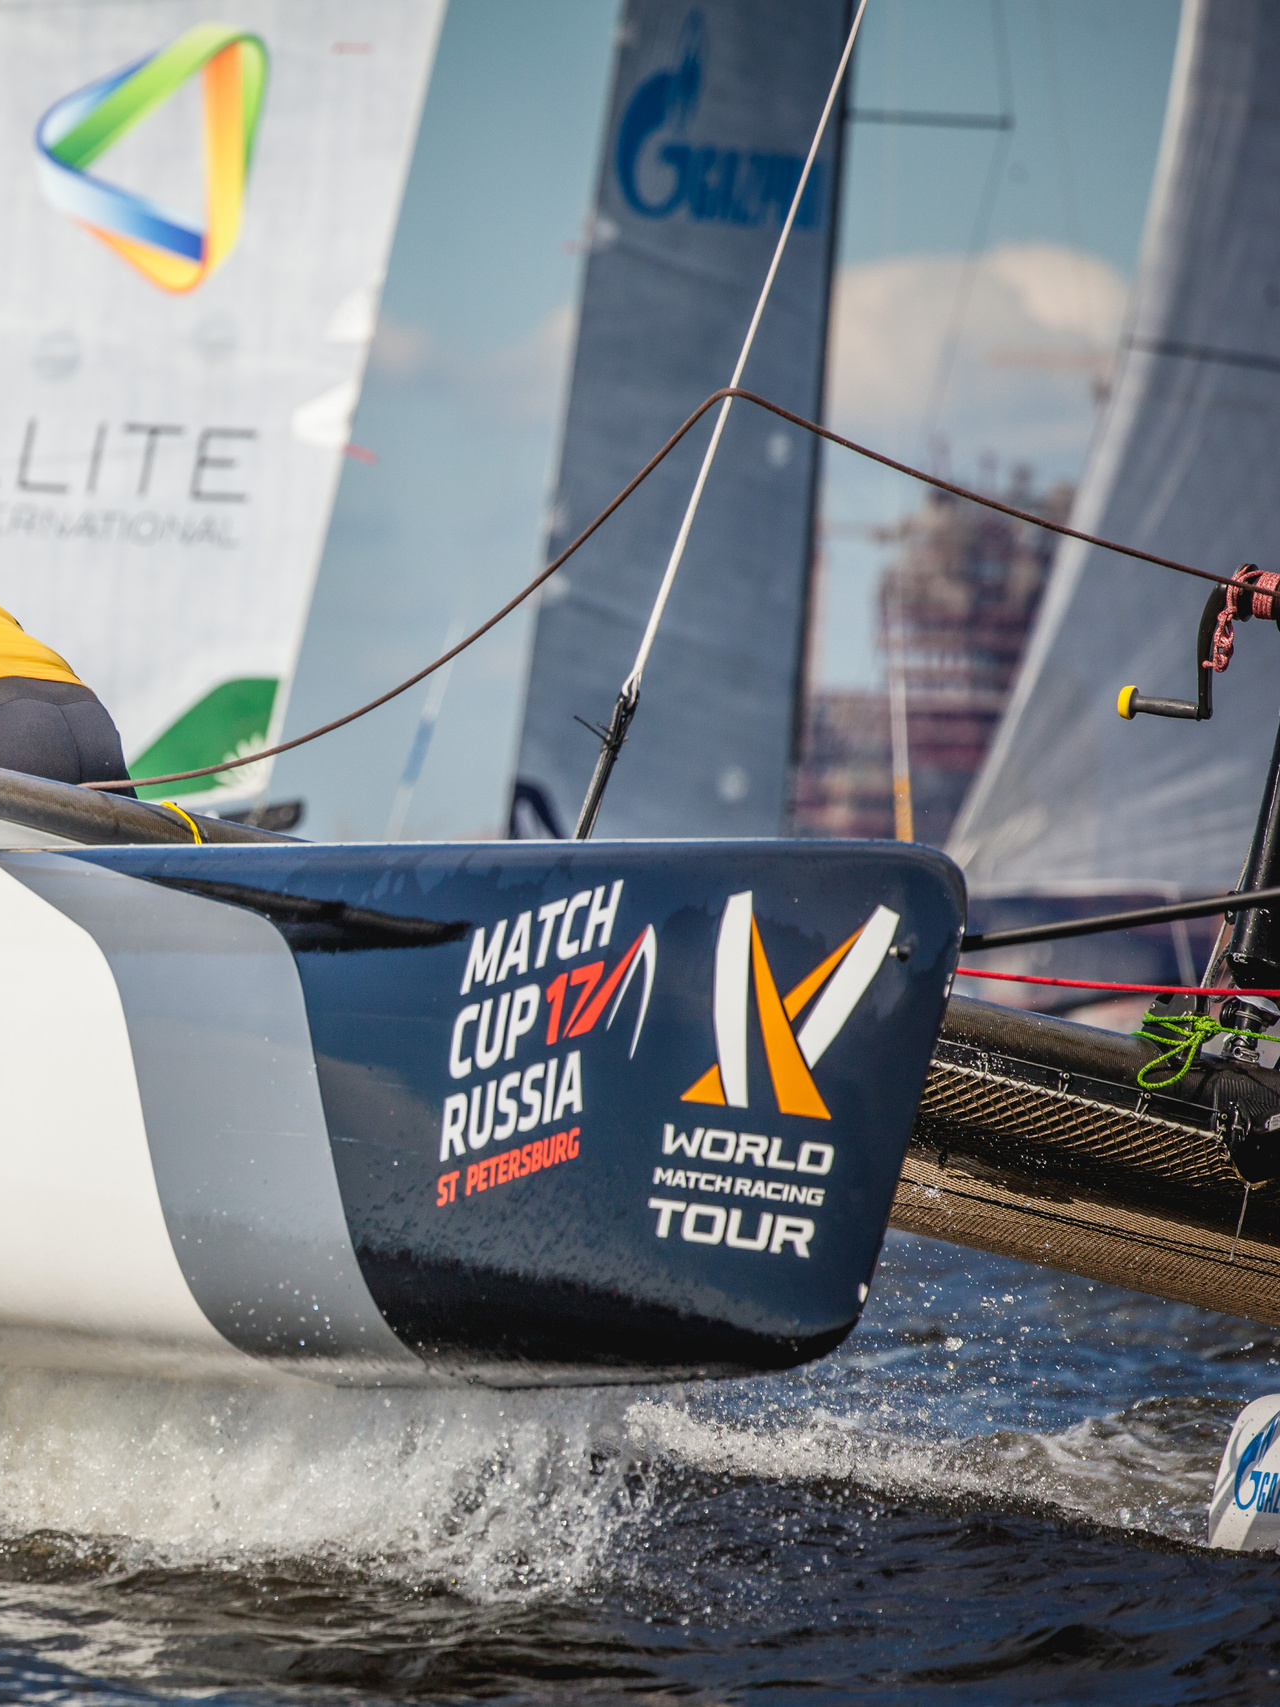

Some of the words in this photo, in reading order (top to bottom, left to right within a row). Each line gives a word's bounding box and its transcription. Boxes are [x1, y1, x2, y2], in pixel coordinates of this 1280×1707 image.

[459, 879, 624, 995] MATCH
[449, 983, 541, 1079] CUP
[439, 1050, 583, 1162] RUSSIA
[436, 1170, 460, 1207] ST
[465, 1127, 580, 1196] PETERSBURG
[652, 1166, 732, 1195] MATCH
[733, 1176, 826, 1207] RACING
[662, 1123, 834, 1175] WORLD
[648, 1197, 815, 1259] TOUR
